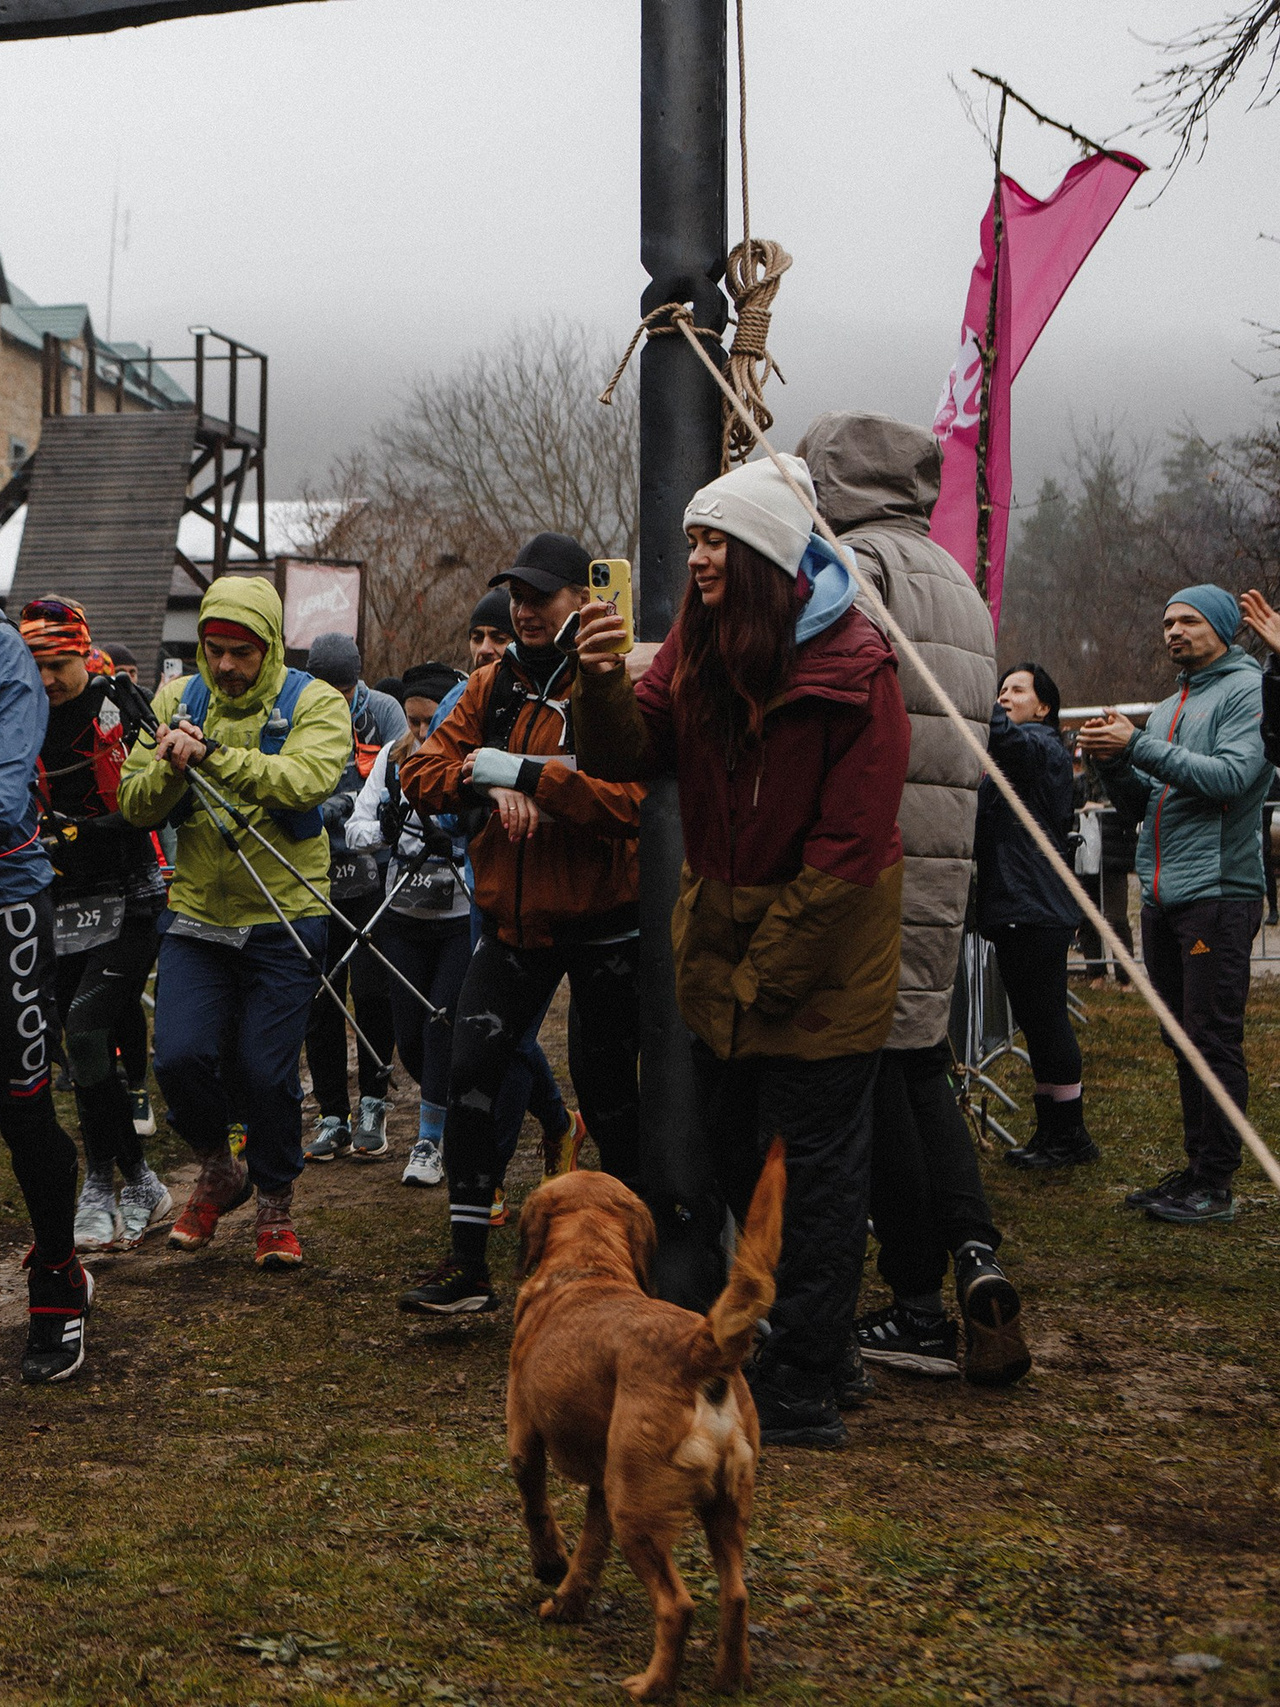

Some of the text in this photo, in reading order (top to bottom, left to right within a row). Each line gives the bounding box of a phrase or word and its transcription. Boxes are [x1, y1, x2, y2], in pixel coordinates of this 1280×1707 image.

[335, 863, 357, 879] 219
[410, 872, 432, 889] 236
[76, 909, 101, 928] 225
